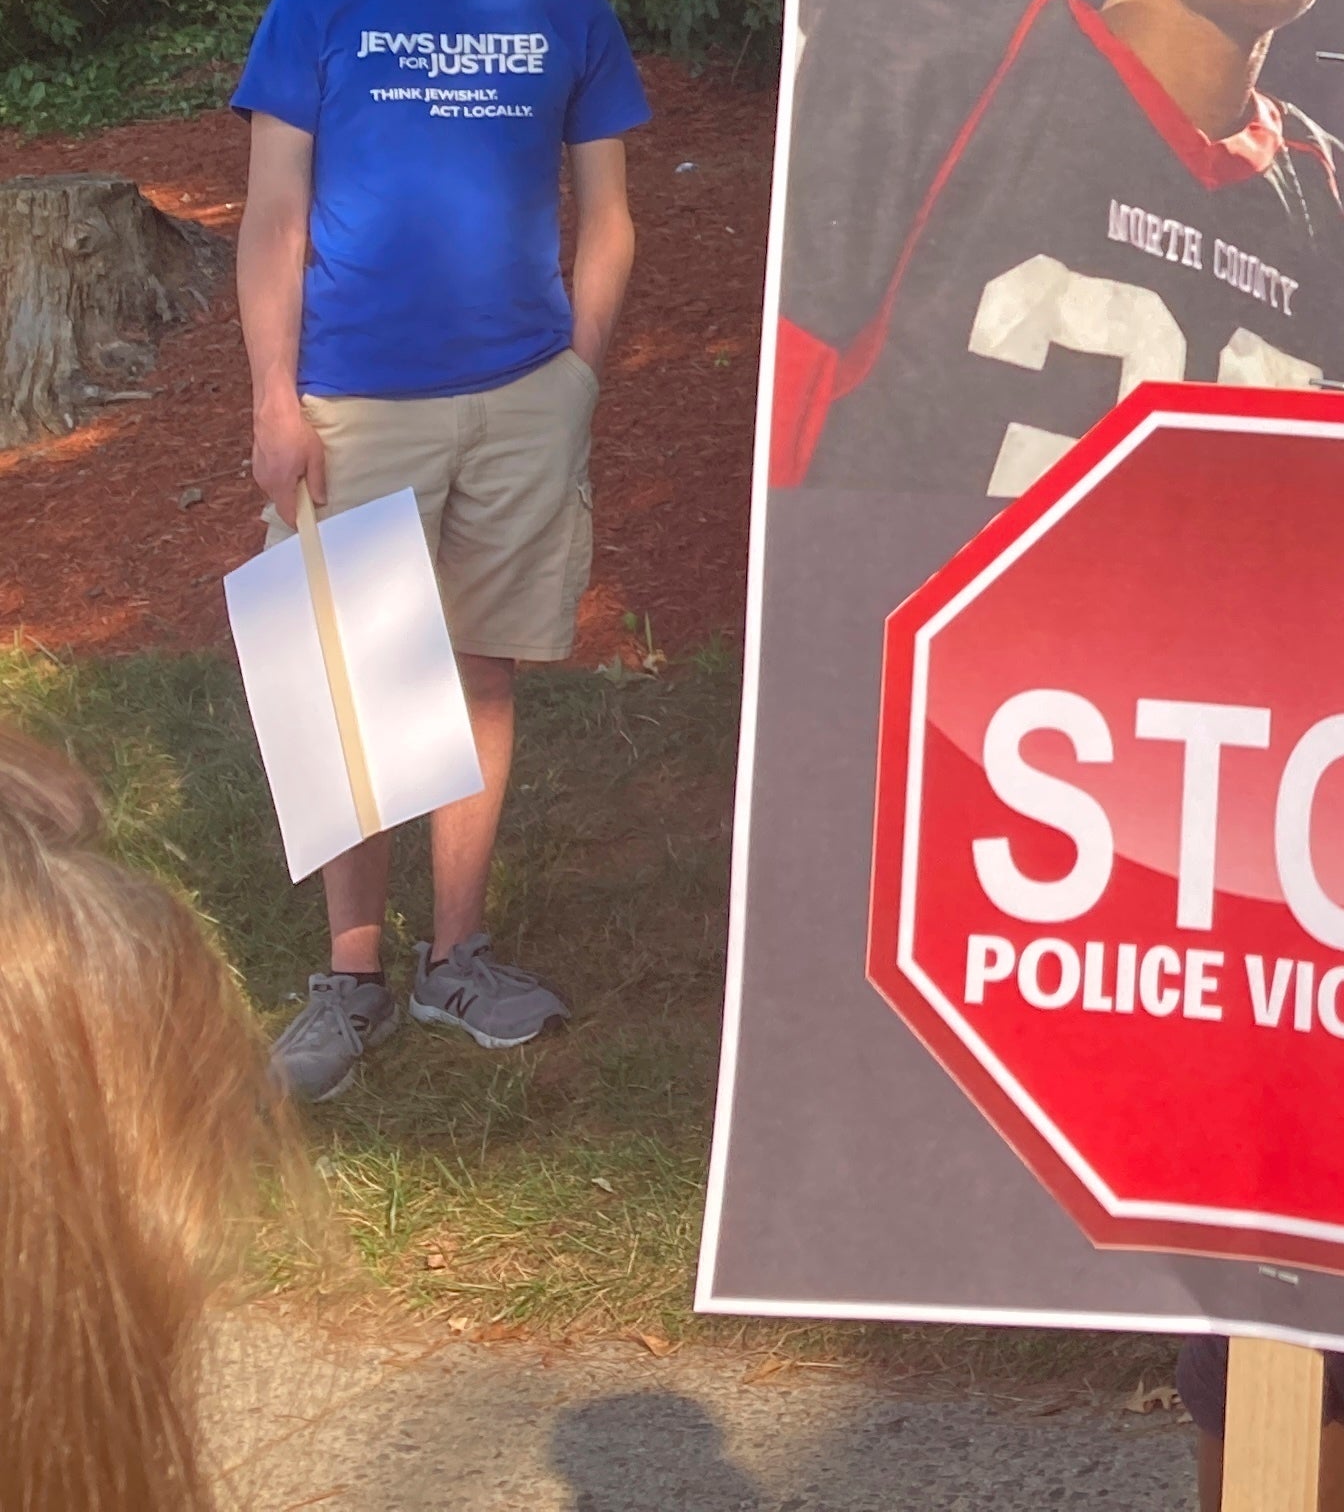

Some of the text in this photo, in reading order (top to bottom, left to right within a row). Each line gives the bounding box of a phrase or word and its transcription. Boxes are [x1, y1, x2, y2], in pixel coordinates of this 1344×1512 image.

[357, 31, 549, 58] JEWS UNITED
[399, 53, 545, 78] FOR JUSTICE
[369, 88, 423, 102] THINK
[429, 105, 461, 118] ACT
[1107, 199, 1203, 271] NORTH
[964, 933, 1225, 1021] POLICE
